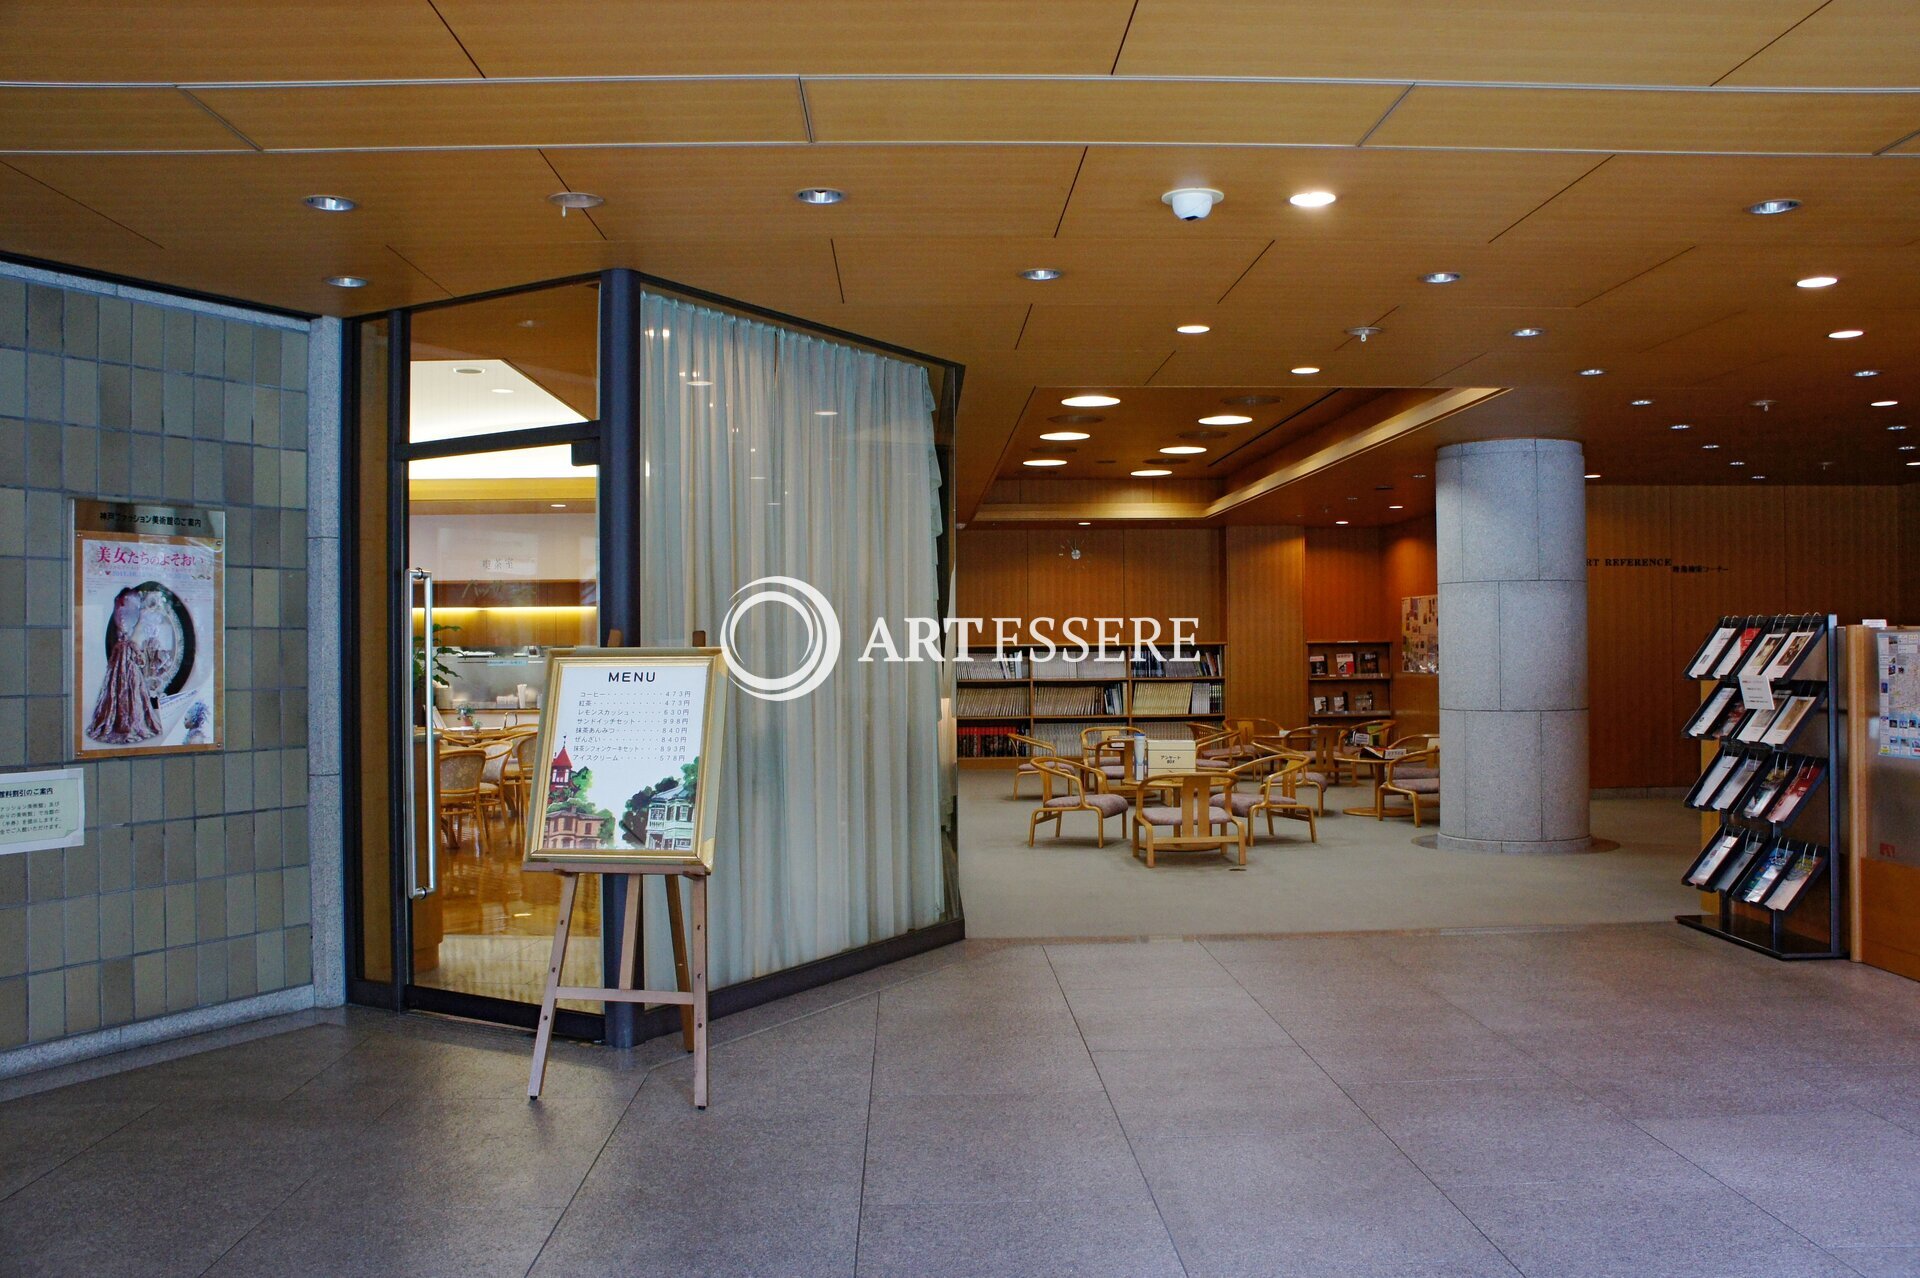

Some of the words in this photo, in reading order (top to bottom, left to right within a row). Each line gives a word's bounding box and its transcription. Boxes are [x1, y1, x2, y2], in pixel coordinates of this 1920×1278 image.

[99, 512, 202, 528] 神戸ファッション美術館のご案内
[97, 546, 204, 567] 美女たちのよそおい
[1586, 559, 1600, 567] RT
[1605, 559, 1673, 567] REFERENCE
[608, 671, 657, 683] MENU
